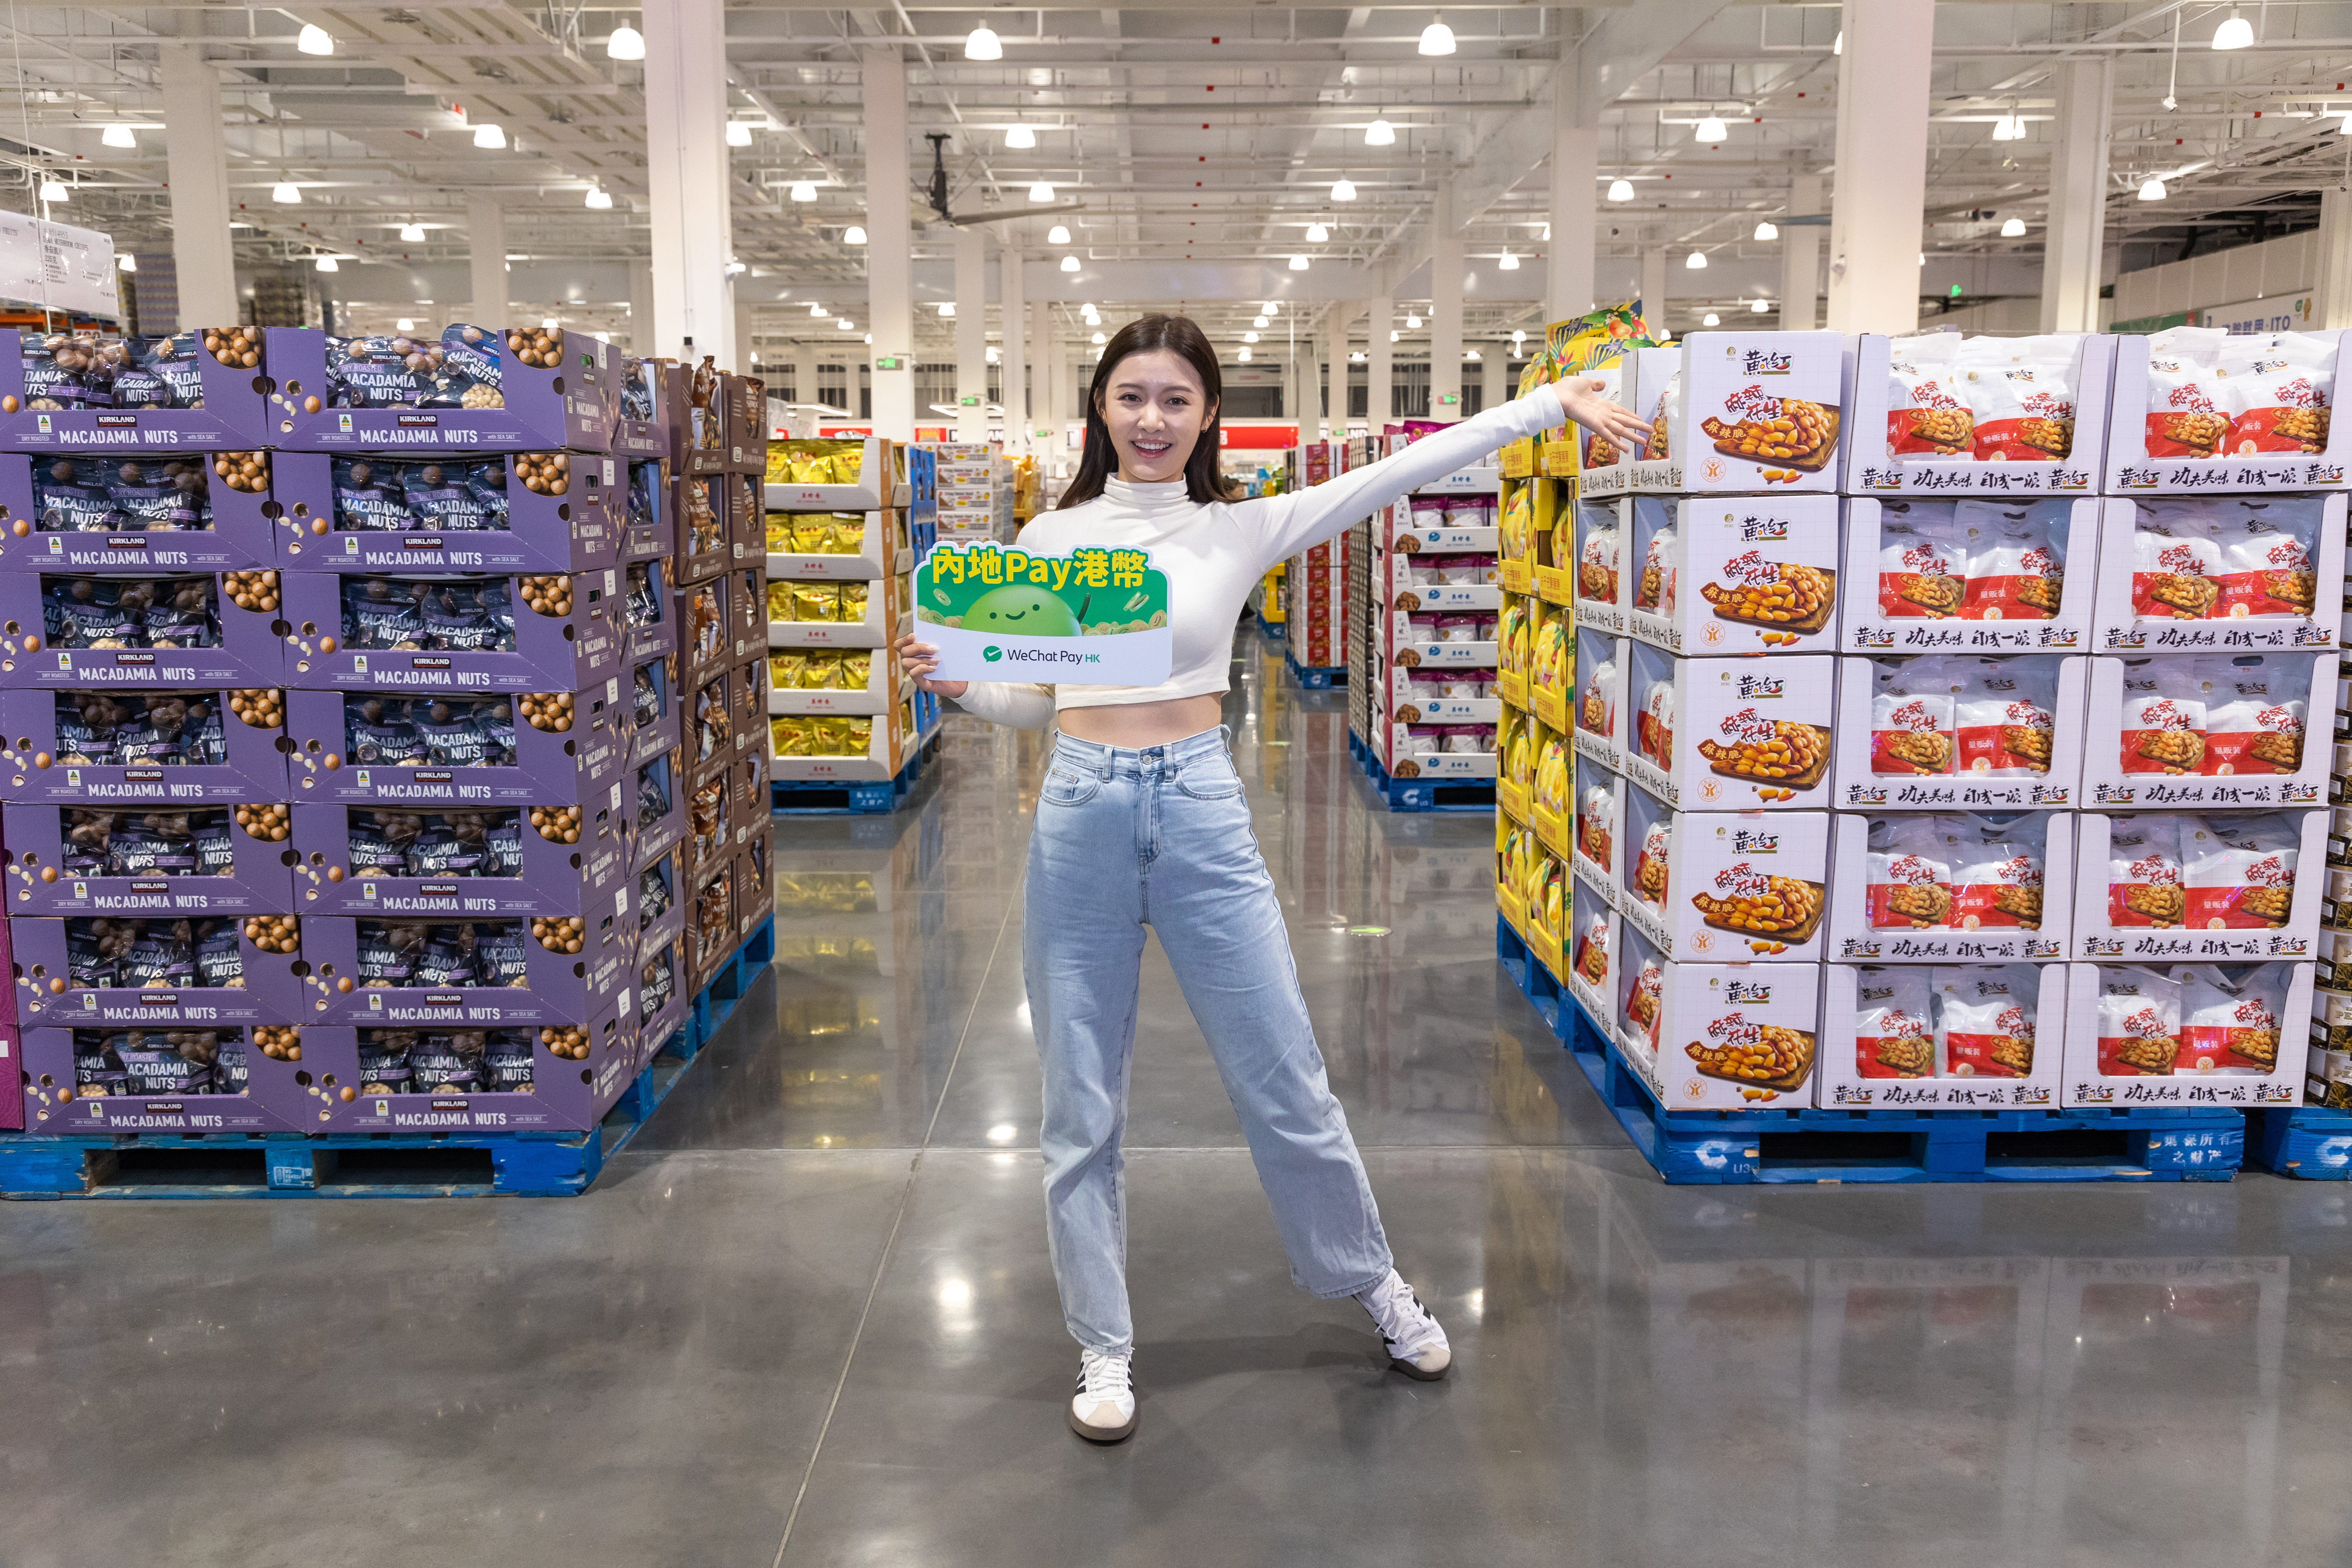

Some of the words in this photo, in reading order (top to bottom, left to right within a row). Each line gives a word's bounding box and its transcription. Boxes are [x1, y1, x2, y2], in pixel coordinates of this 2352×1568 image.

[1742, 350, 1792, 375] 黄飞红
[468, 364, 497, 386] NUTS
[370, 388, 402, 401] NUTS
[1725, 384, 1765, 412] 麻辣
[2167, 383, 2202, 408] 麻辣
[2297, 390, 2326, 409] 花生
[1746, 400, 1780, 421] 花生
[2189, 398, 2215, 414] 花生
[59, 431, 139, 443] MACADAMIA
[144, 430, 178, 443] NUTS
[360, 430, 439, 443] MACADAMIA
[445, 430, 477, 443] NUTS
[1705, 421, 1746, 438] 麻辣脆
[1861, 468, 1903, 489] 黄飞红
[1913, 469, 1971, 489] 功夫美味
[1981, 472, 2040, 490] 自成一派
[2048, 469, 2088, 490] 黄飞红
[2118, 467, 2160, 488] 黄飞红
[2170, 467, 2228, 487] 功夫美味
[2237, 467, 2296, 486] 自成一派
[2305, 463, 2344, 484] 黄飞红
[373, 481, 400, 491] KIRKLAND
[342, 498, 411, 517] MACADAMIA
[367, 514, 399, 529] NUTS
[1740, 516, 1788, 541] 黄飞红
[70, 552, 149, 564] MACADAMIA
[154, 552, 187, 564] NUTS
[366, 552, 444, 564] MACADAMIA
[450, 552, 482, 565] NUTS
[1723, 550, 1763, 578] 麻辣
[1902, 543, 1936, 568] 麻辣
[2157, 544, 2194, 568] 麻辣
[1745, 565, 1778, 585] 花生
[1920, 559, 1949, 576] 花生
[2174, 559, 2206, 576] 花生
[1705, 586, 1745, 603] 麻辣脆
[1980, 589, 2006, 598] 量贩装
[2226, 585, 2253, 594] 量贩装
[1855, 627, 1895, 647] 黄飞红
[1906, 628, 1963, 647] 功夫美味
[1972, 630, 2030, 647] 自成一派
[2038, 627, 2078, 647] 黄飞红
[2105, 628, 2147, 648] 黄飞红
[2157, 628, 2215, 647] 功夫美味
[2224, 630, 2283, 647] 自成一派
[2291, 626, 2331, 646] 黄飞红
[1008, 649, 1057, 661] WeChat
[1061, 651, 1082, 665] Pay
[1085, 653, 1101, 663] HK
[79, 668, 157, 680] MACADAMIA
[163, 668, 195, 680] NUTS
[374, 671, 451, 684] MACADAMIA
[458, 672, 490, 685] NUTS
[1737, 675, 1784, 699] 黄飞红
[1720, 708, 1759, 735] 麻辣
[1741, 723, 1774, 742] 花生
[1702, 743, 1742, 759] 麻辣脆
[2215, 746, 2241, 755] 量贩装
[88, 784, 165, 796] MACADAMIA
[171, 784, 202, 796] NUTS
[377, 785, 453, 797] MACADAMIA
[459, 786, 491, 798] NUTS
[1847, 784, 1888, 804] 黄飞红
[1898, 786, 1955, 804] 功夫美味
[1964, 788, 2021, 805] 自成一派
[2030, 785, 2068, 804] 黄飞红
[2094, 784, 2136, 803] 黄飞红
[2146, 784, 2203, 803] 功夫美味
[2212, 786, 2270, 803] 自成一派
[2279, 783, 2318, 802] 黄飞红
[1732, 830, 1779, 854] 黄飞红
[1714, 862, 1754, 889] 麻辣
[1735, 877, 1767, 896] 花生
[95, 896, 171, 908] MACADAMIA
[176, 896, 207, 907] NUTS
[383, 898, 459, 909] MACADAMIA
[465, 898, 496, 910] NUTS
[1696, 896, 1735, 912] 麻辣脆
[1841, 938, 1882, 957] 黄飞红
[1892, 940, 1948, 957] 功夫美味
[1957, 942, 2014, 958] 自成一派
[2022, 939, 2060, 957] 黄飞红
[2084, 937, 2125, 956] 黄飞红
[2135, 937, 2191, 955] 功夫美味
[2201, 939, 2259, 956] 自成一派
[2267, 936, 2307, 955] 黄飞红
[1725, 981, 1771, 1004] 黄飞红
[104, 1008, 179, 1019] MACADAMIA
[185, 1008, 216, 1019] NUTS
[389, 1008, 463, 1019] MACADAMIA
[469, 1008, 500, 1019] NUTS
[1707, 1012, 1746, 1038] 麻辣
[1727, 1026, 1759, 1045] 花生
[1689, 1045, 1728, 1061] 麻辣脆
[1833, 1085, 1873, 1104] 黄飞红
[1883, 1086, 1939, 1104] 功夫美味
[1947, 1089, 2004, 1105] 自成一派
[2012, 1086, 2050, 1104] 黄飞红
[2074, 1084, 2114, 1102] 黄飞红
[2125, 1084, 2181, 1101] 功夫美味
[2189, 1086, 2246, 1102] 自成一派
[2253, 1083, 2293, 1102] 黄飞红
[110, 1116, 185, 1126] MACADAMIA
[191, 1115, 223, 1126] NUTS
[395, 1113, 470, 1125] MACADAMIA
[475, 1113, 506, 1125] NUTS
[1733, 1163, 1750, 1173] U3
